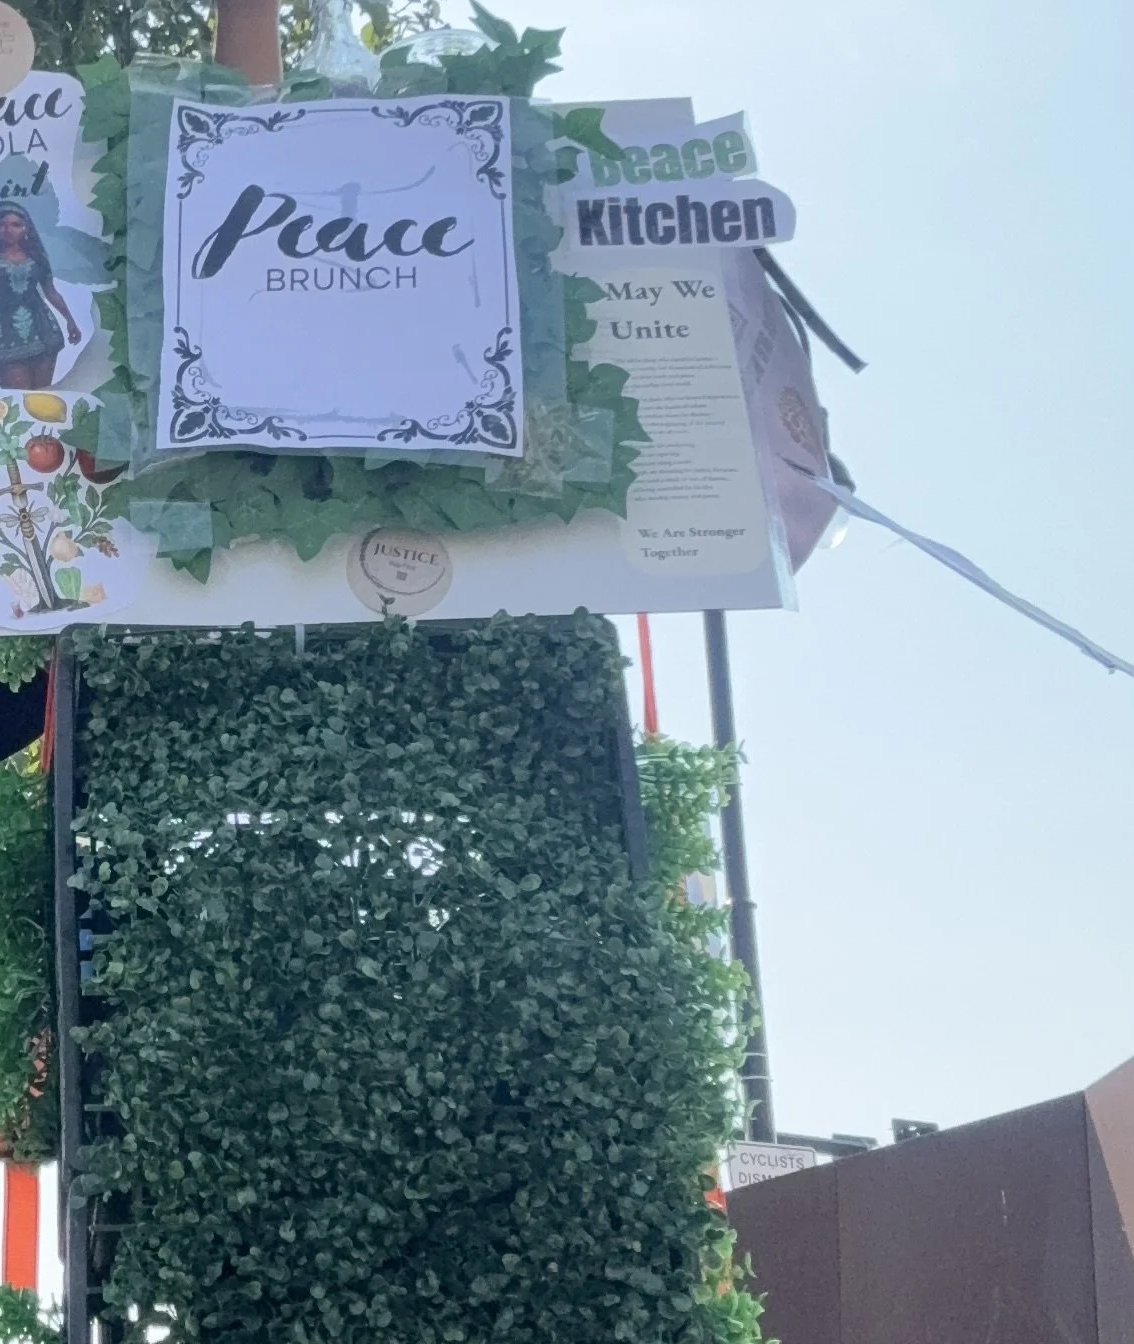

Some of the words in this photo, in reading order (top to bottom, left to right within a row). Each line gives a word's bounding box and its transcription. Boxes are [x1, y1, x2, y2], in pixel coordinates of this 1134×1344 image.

[192, 184, 475, 280] Peace
[577, 195, 776, 246] Kitchen
[266, 266, 417, 292] BRUNCH
[604, 281, 663, 306] May
[672, 279, 716, 299] We
[610, 320, 690, 340] Unite
[637, 528, 659, 539] We
[662, 528, 686, 538] Are
[688, 527, 747, 540] Stronger
[373, 543, 441, 566] JUSTICE
[640, 546, 699, 561] Together
[739, 1151, 805, 1169] CYCLISTS
